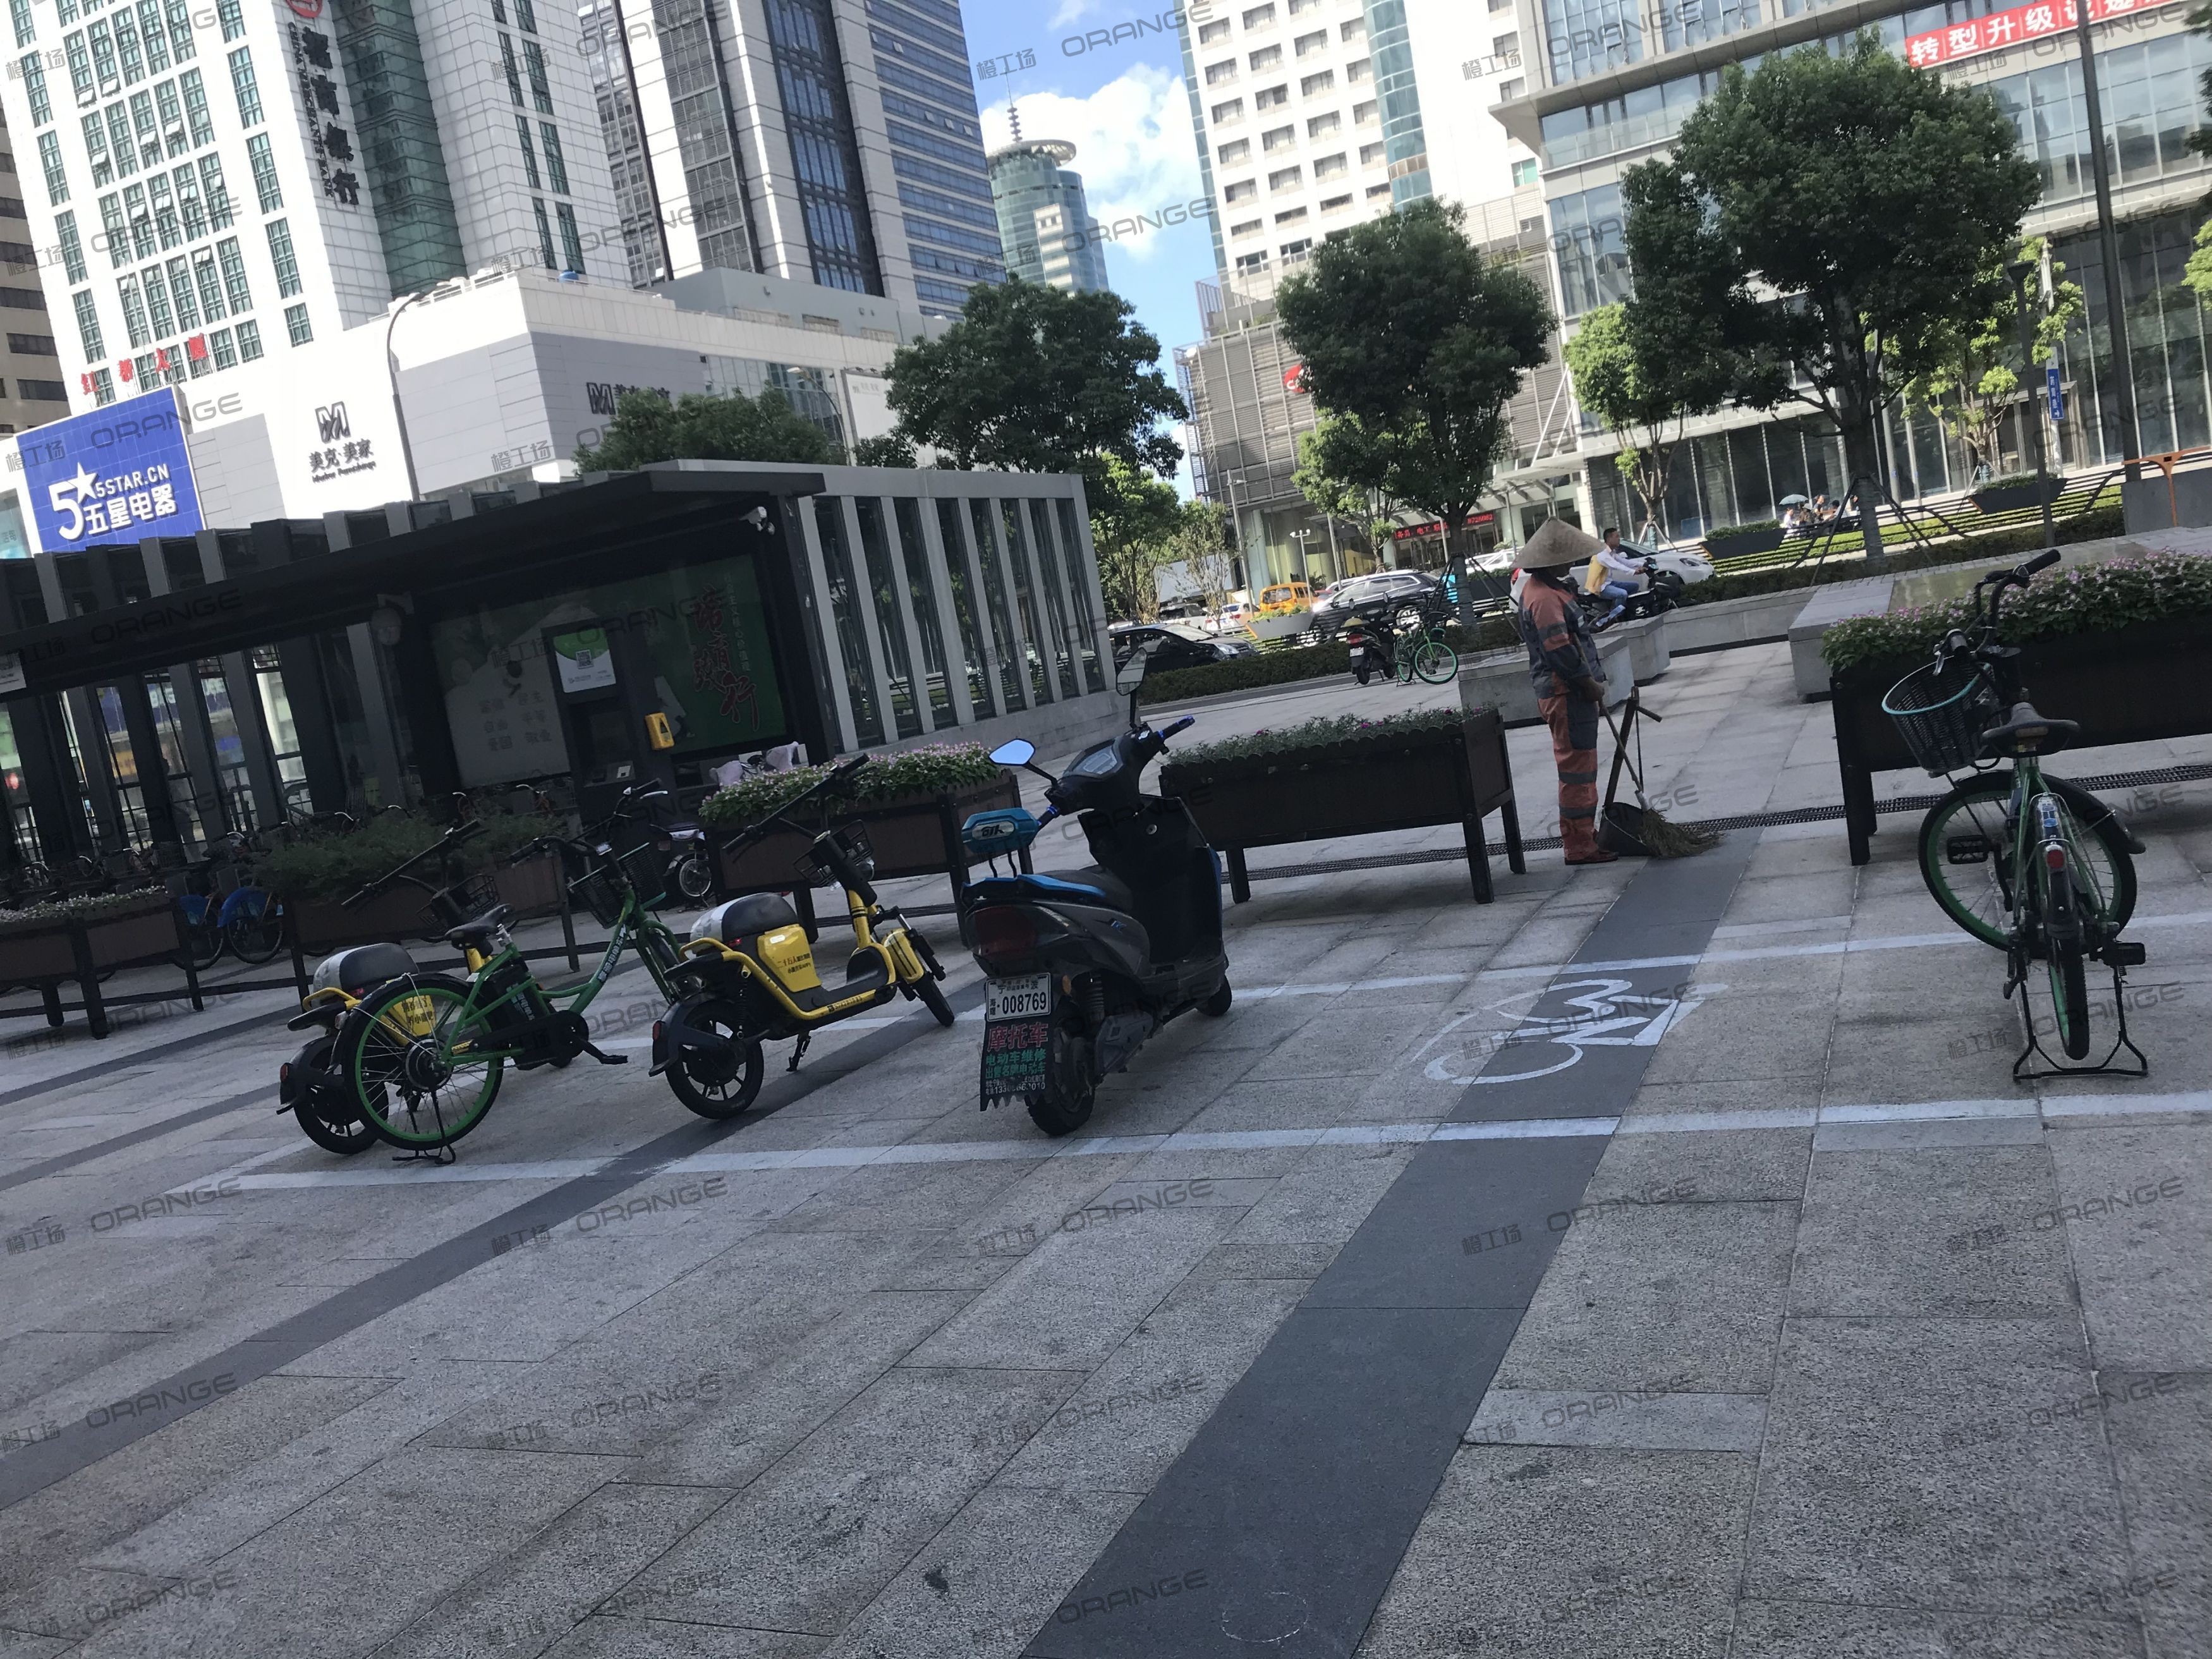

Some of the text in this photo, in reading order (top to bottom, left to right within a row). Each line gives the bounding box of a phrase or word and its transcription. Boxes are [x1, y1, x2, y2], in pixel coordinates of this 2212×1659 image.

[288, 21, 334, 197] CHINA MERCHANTS BANK
[302, 26, 360, 205] 招商银行
[95, 463, 170, 498] 5STAR.CN
[83, 483, 177, 535] 五星电器
[1002, 992, 1047, 1014] 008769
[987, 1022, 1049, 1052] 摩托车
[985, 1062, 1046, 1079] 出售名牌电动车
[986, 1048, 1047, 1066] 电动车维修
